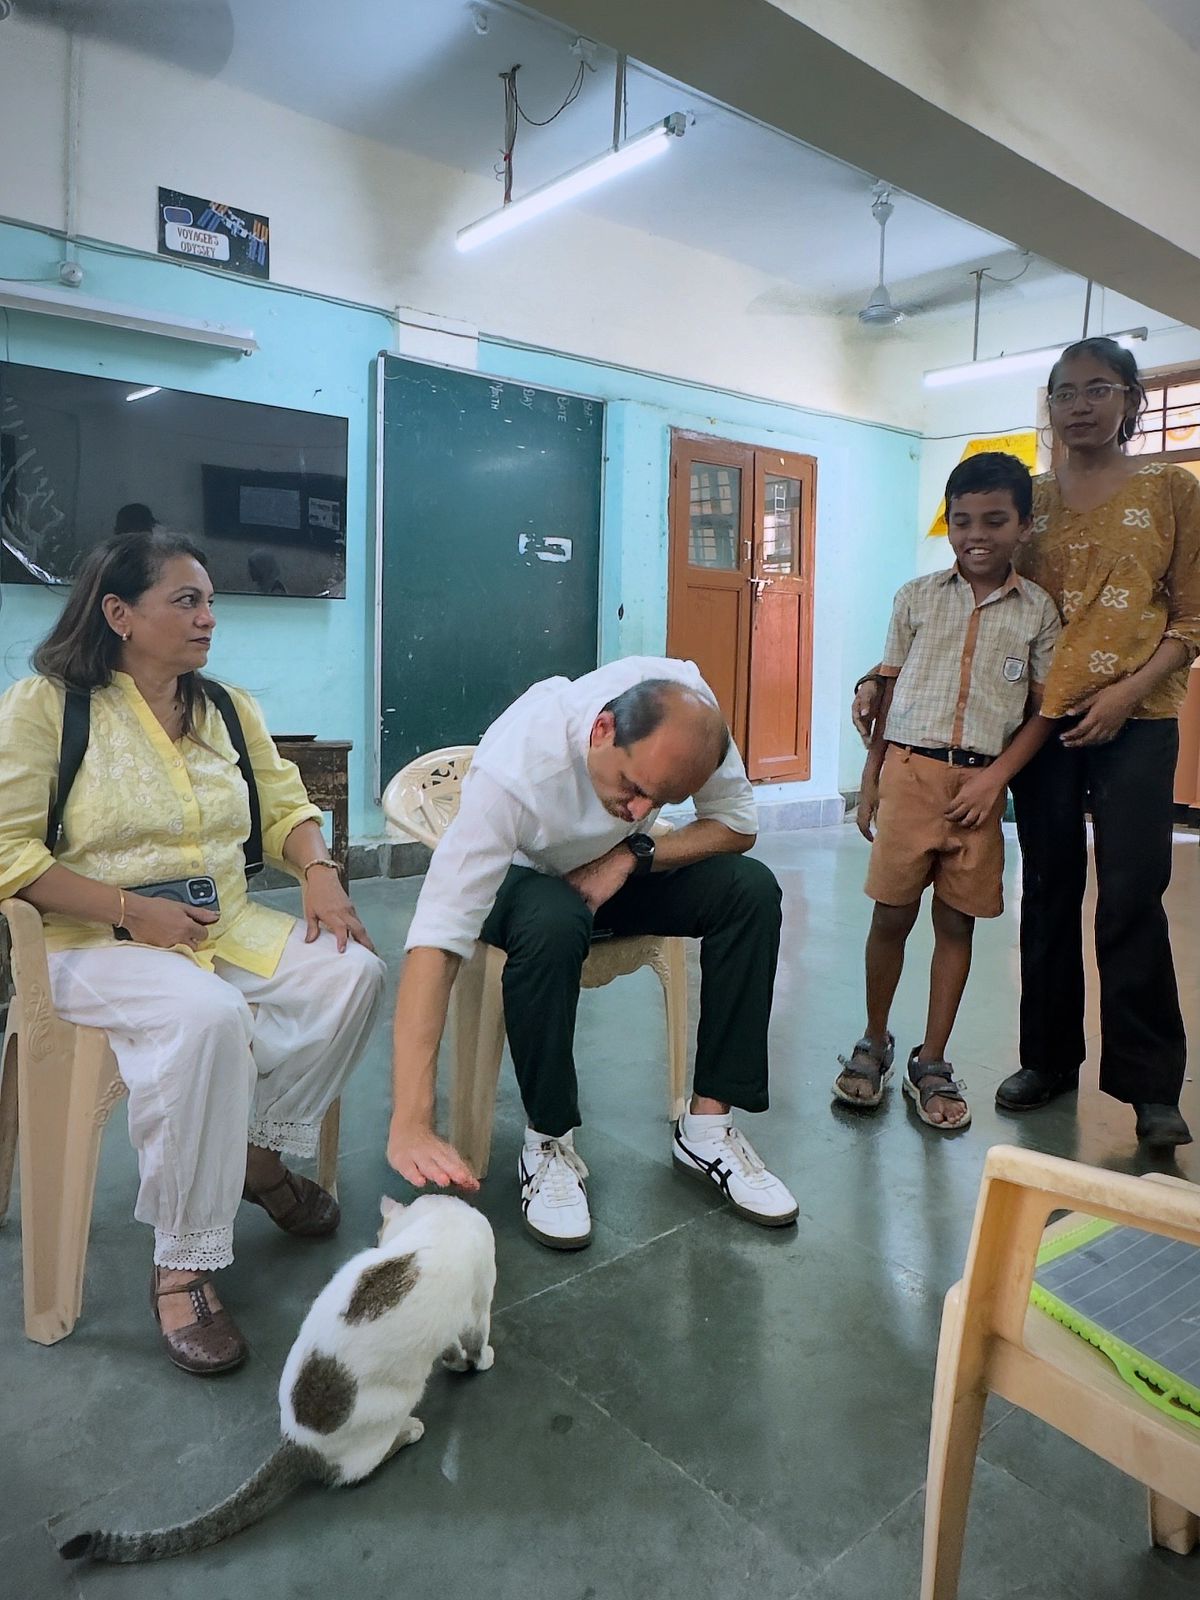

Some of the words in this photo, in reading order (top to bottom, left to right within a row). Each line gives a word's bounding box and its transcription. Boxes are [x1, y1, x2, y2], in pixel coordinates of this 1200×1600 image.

[181, 241, 215, 258] ODYSSEY
[521, 388, 535, 410] DAY
[557, 396, 569, 422] DATE
